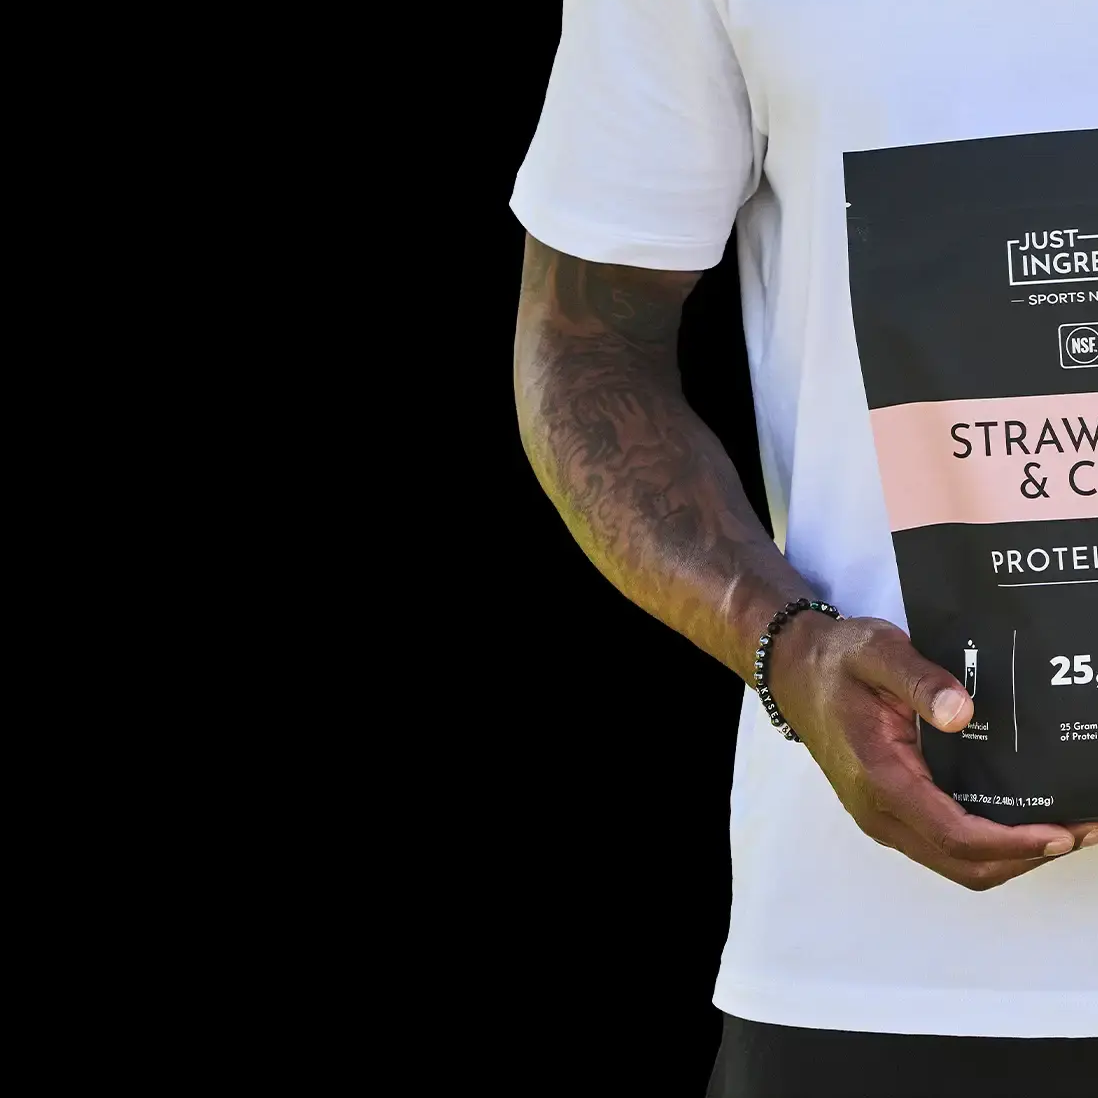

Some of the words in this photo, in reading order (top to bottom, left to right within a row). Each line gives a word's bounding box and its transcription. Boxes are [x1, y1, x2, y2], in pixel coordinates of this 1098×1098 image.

[1019, 229, 1078, 251] JUST
[1028, 291, 1086, 306] SPORTS
[1020, 461, 1050, 499] &
[1060, 722, 1071, 731] 25
[1060, 733, 1070, 742] of
[1016, 795, 1054, 808] (1,128g)
